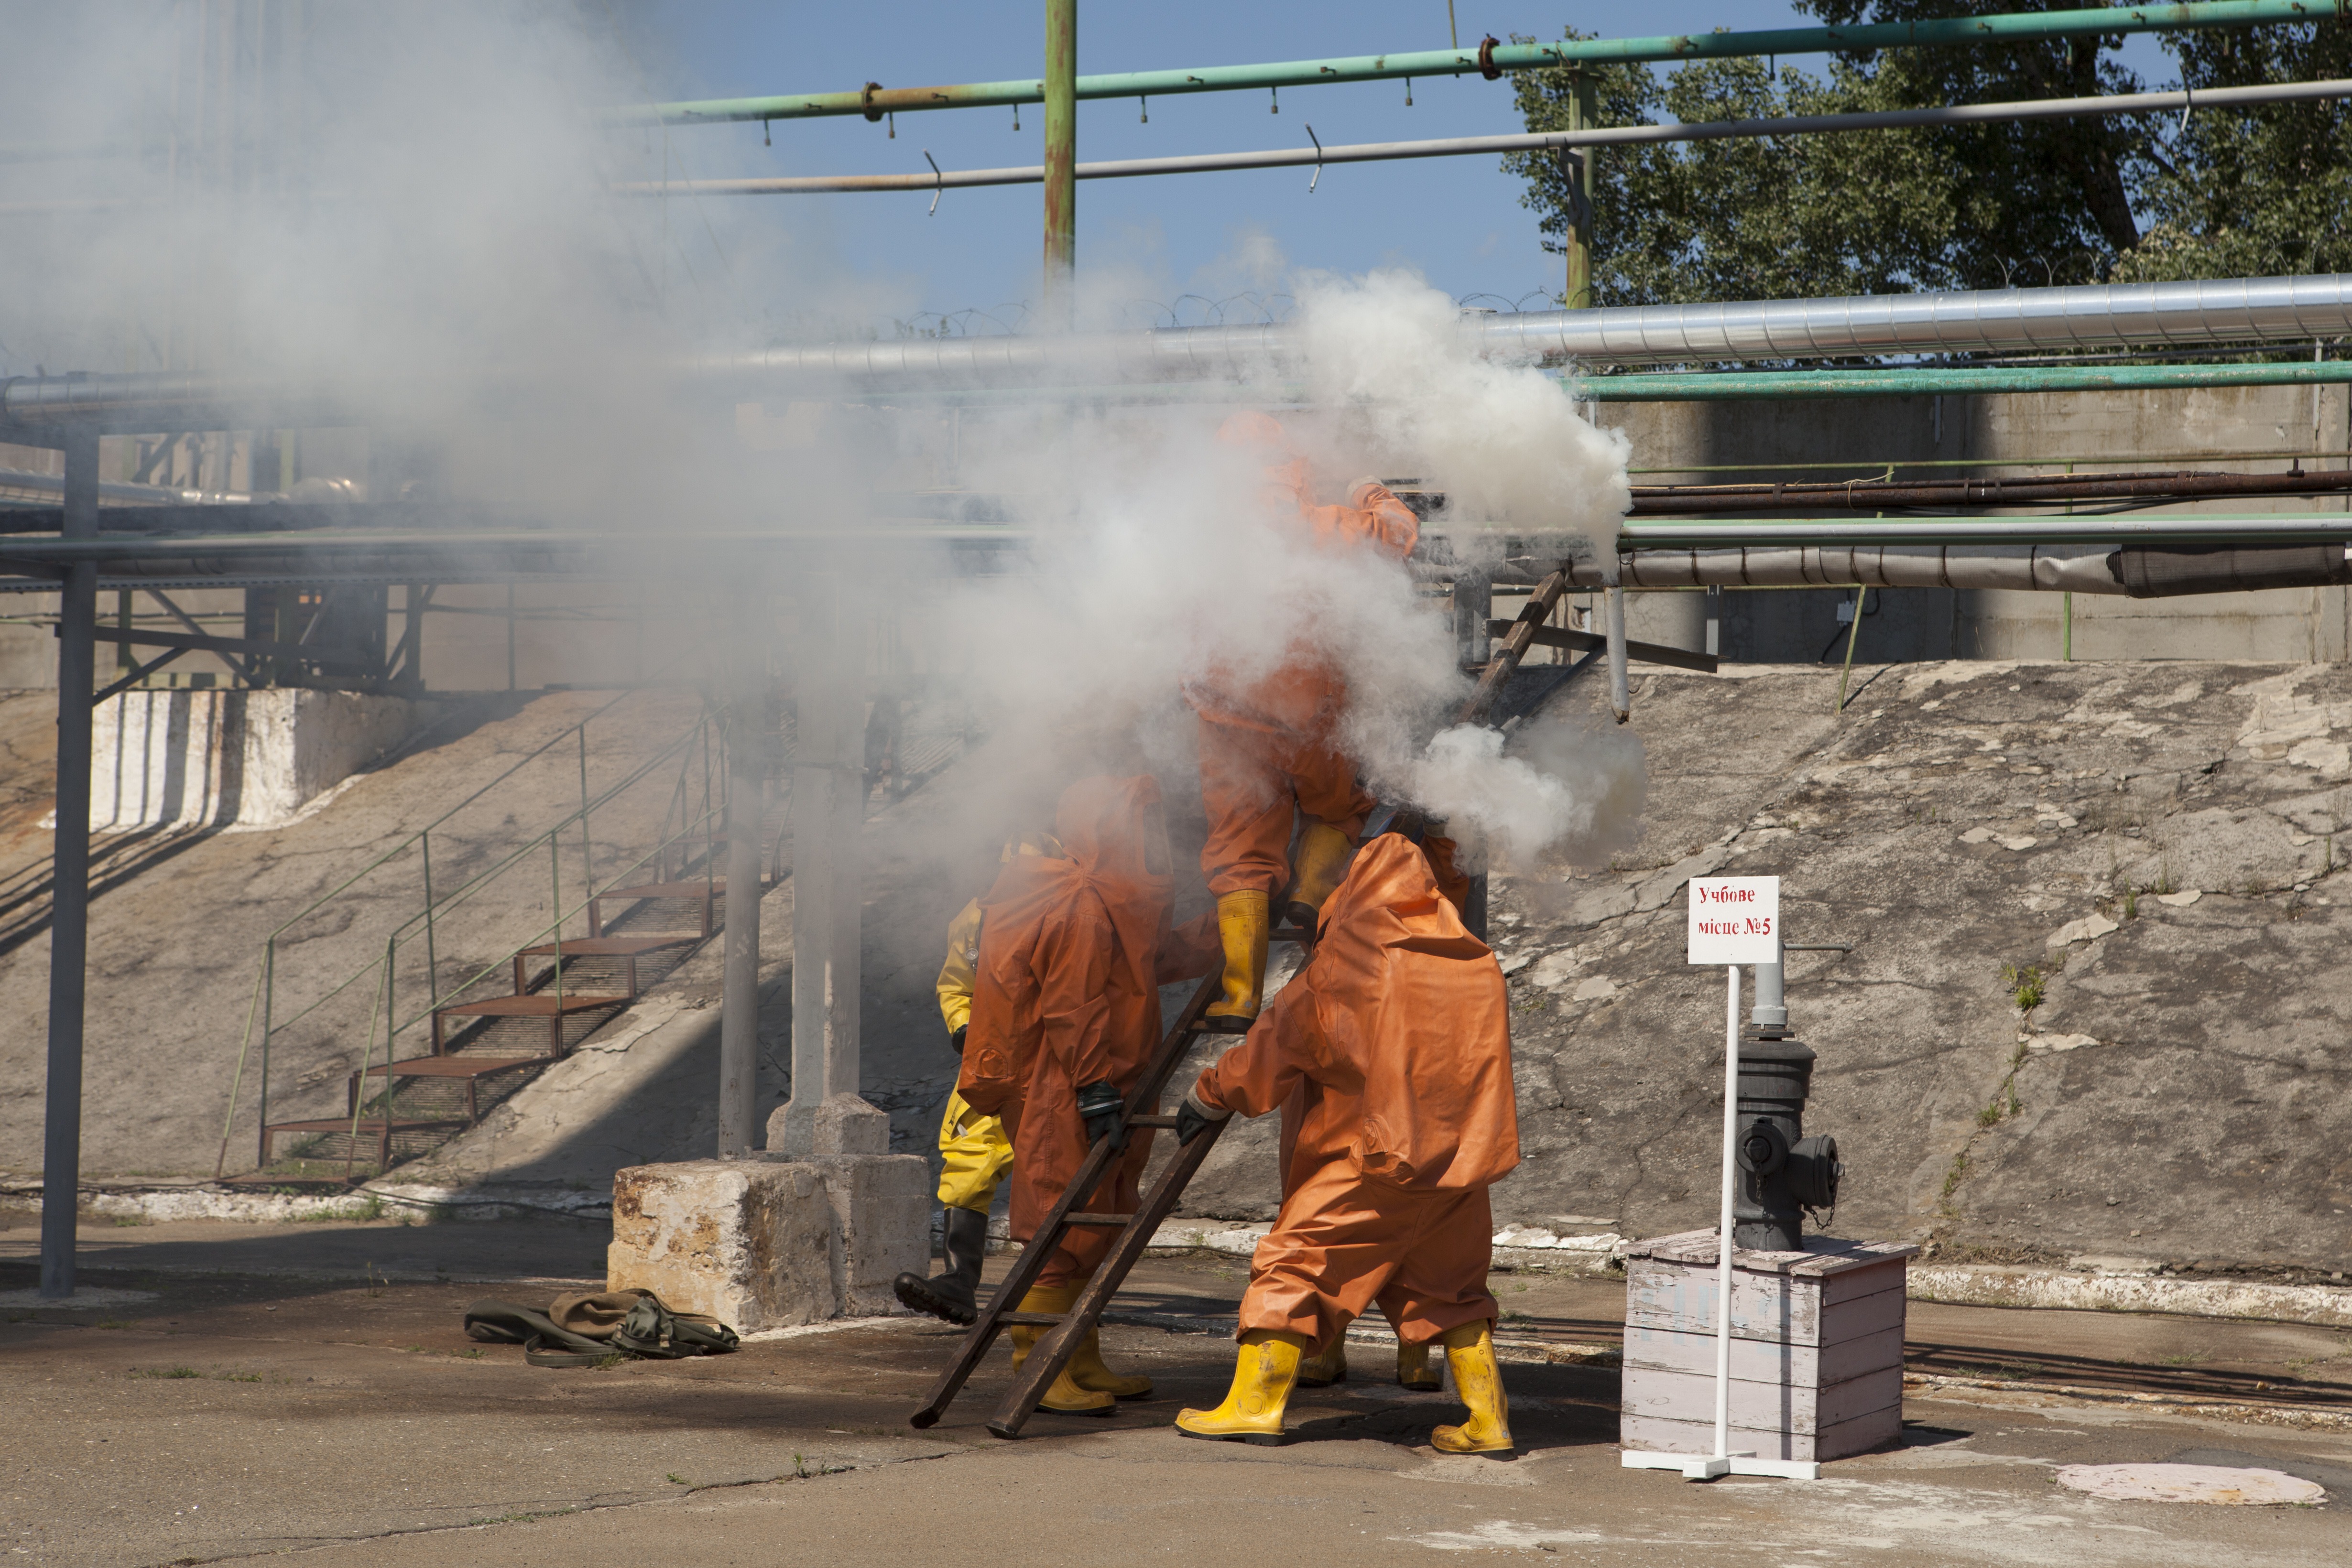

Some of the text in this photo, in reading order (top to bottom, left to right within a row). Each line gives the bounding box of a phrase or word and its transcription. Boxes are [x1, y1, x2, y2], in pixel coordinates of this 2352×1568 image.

[1699, 886, 1755, 903] Учбове
[1699, 918, 1770, 935] місце №5
